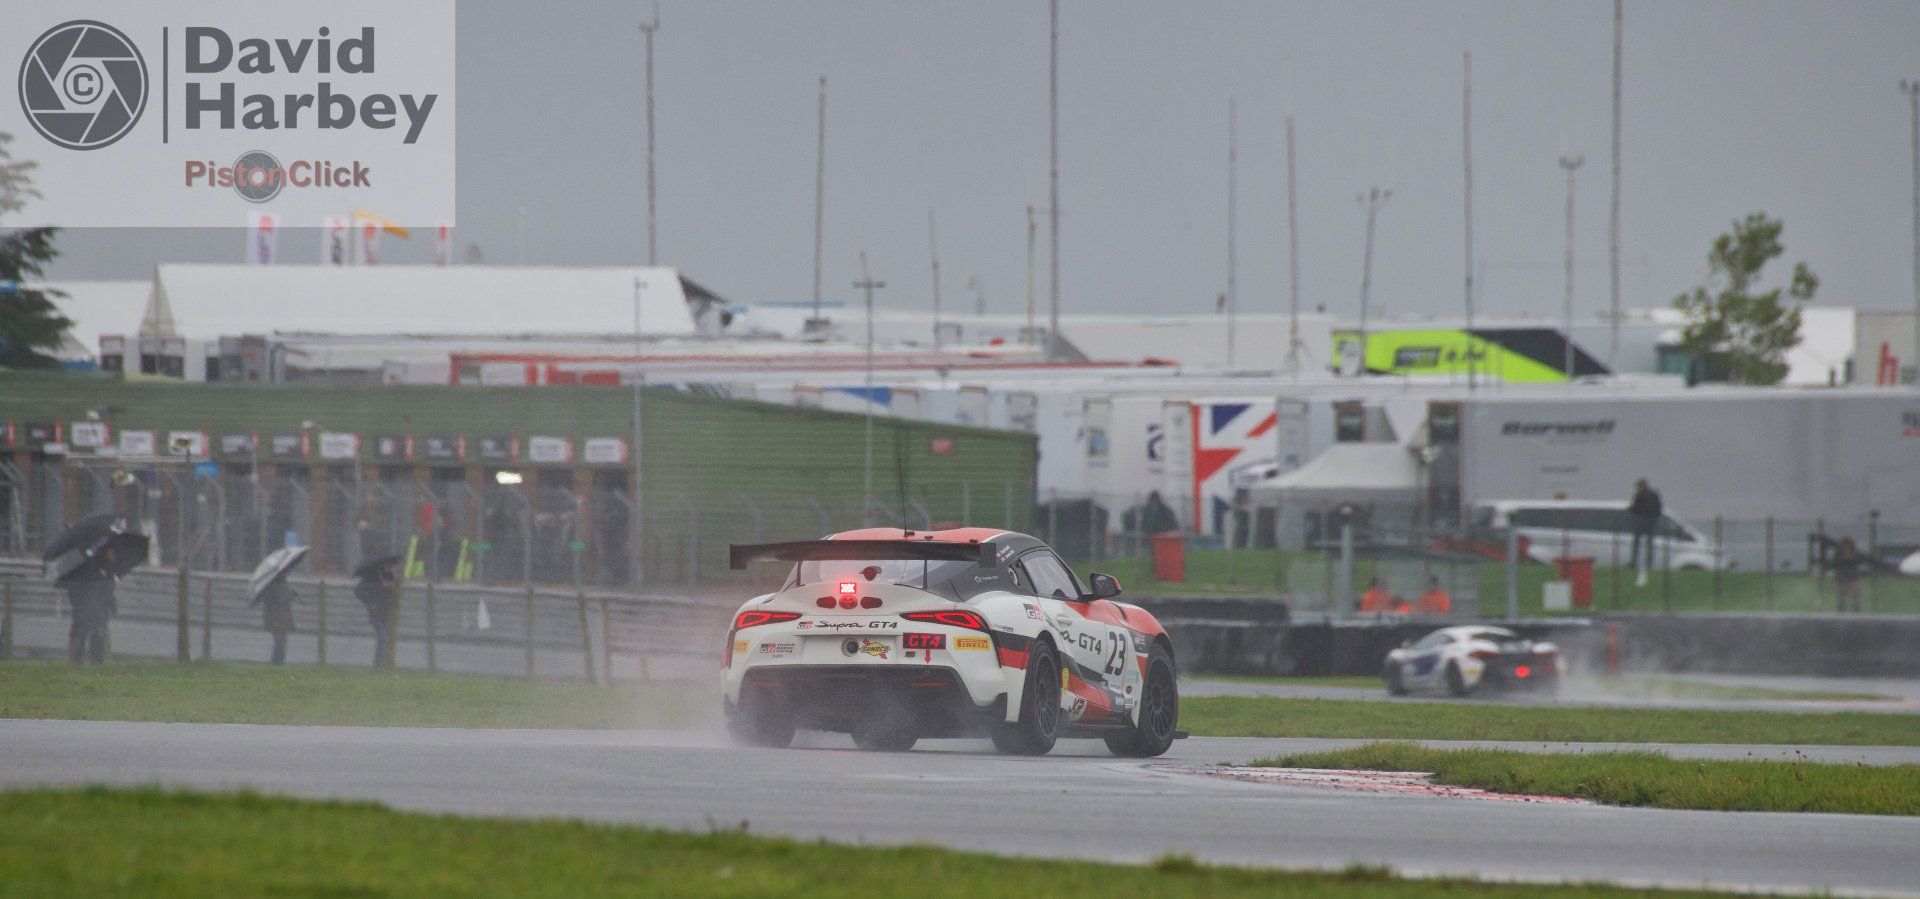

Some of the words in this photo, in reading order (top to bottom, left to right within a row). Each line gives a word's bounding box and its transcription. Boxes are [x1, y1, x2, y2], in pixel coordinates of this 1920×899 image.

[815, 621, 866, 631] Supra
[868, 621, 897, 629] GT4
[909, 634, 940, 647] GT4
[957, 639, 987, 648] PIRELLI
[1079, 633, 1101, 655] GT4
[1104, 631, 1126, 675] 23
